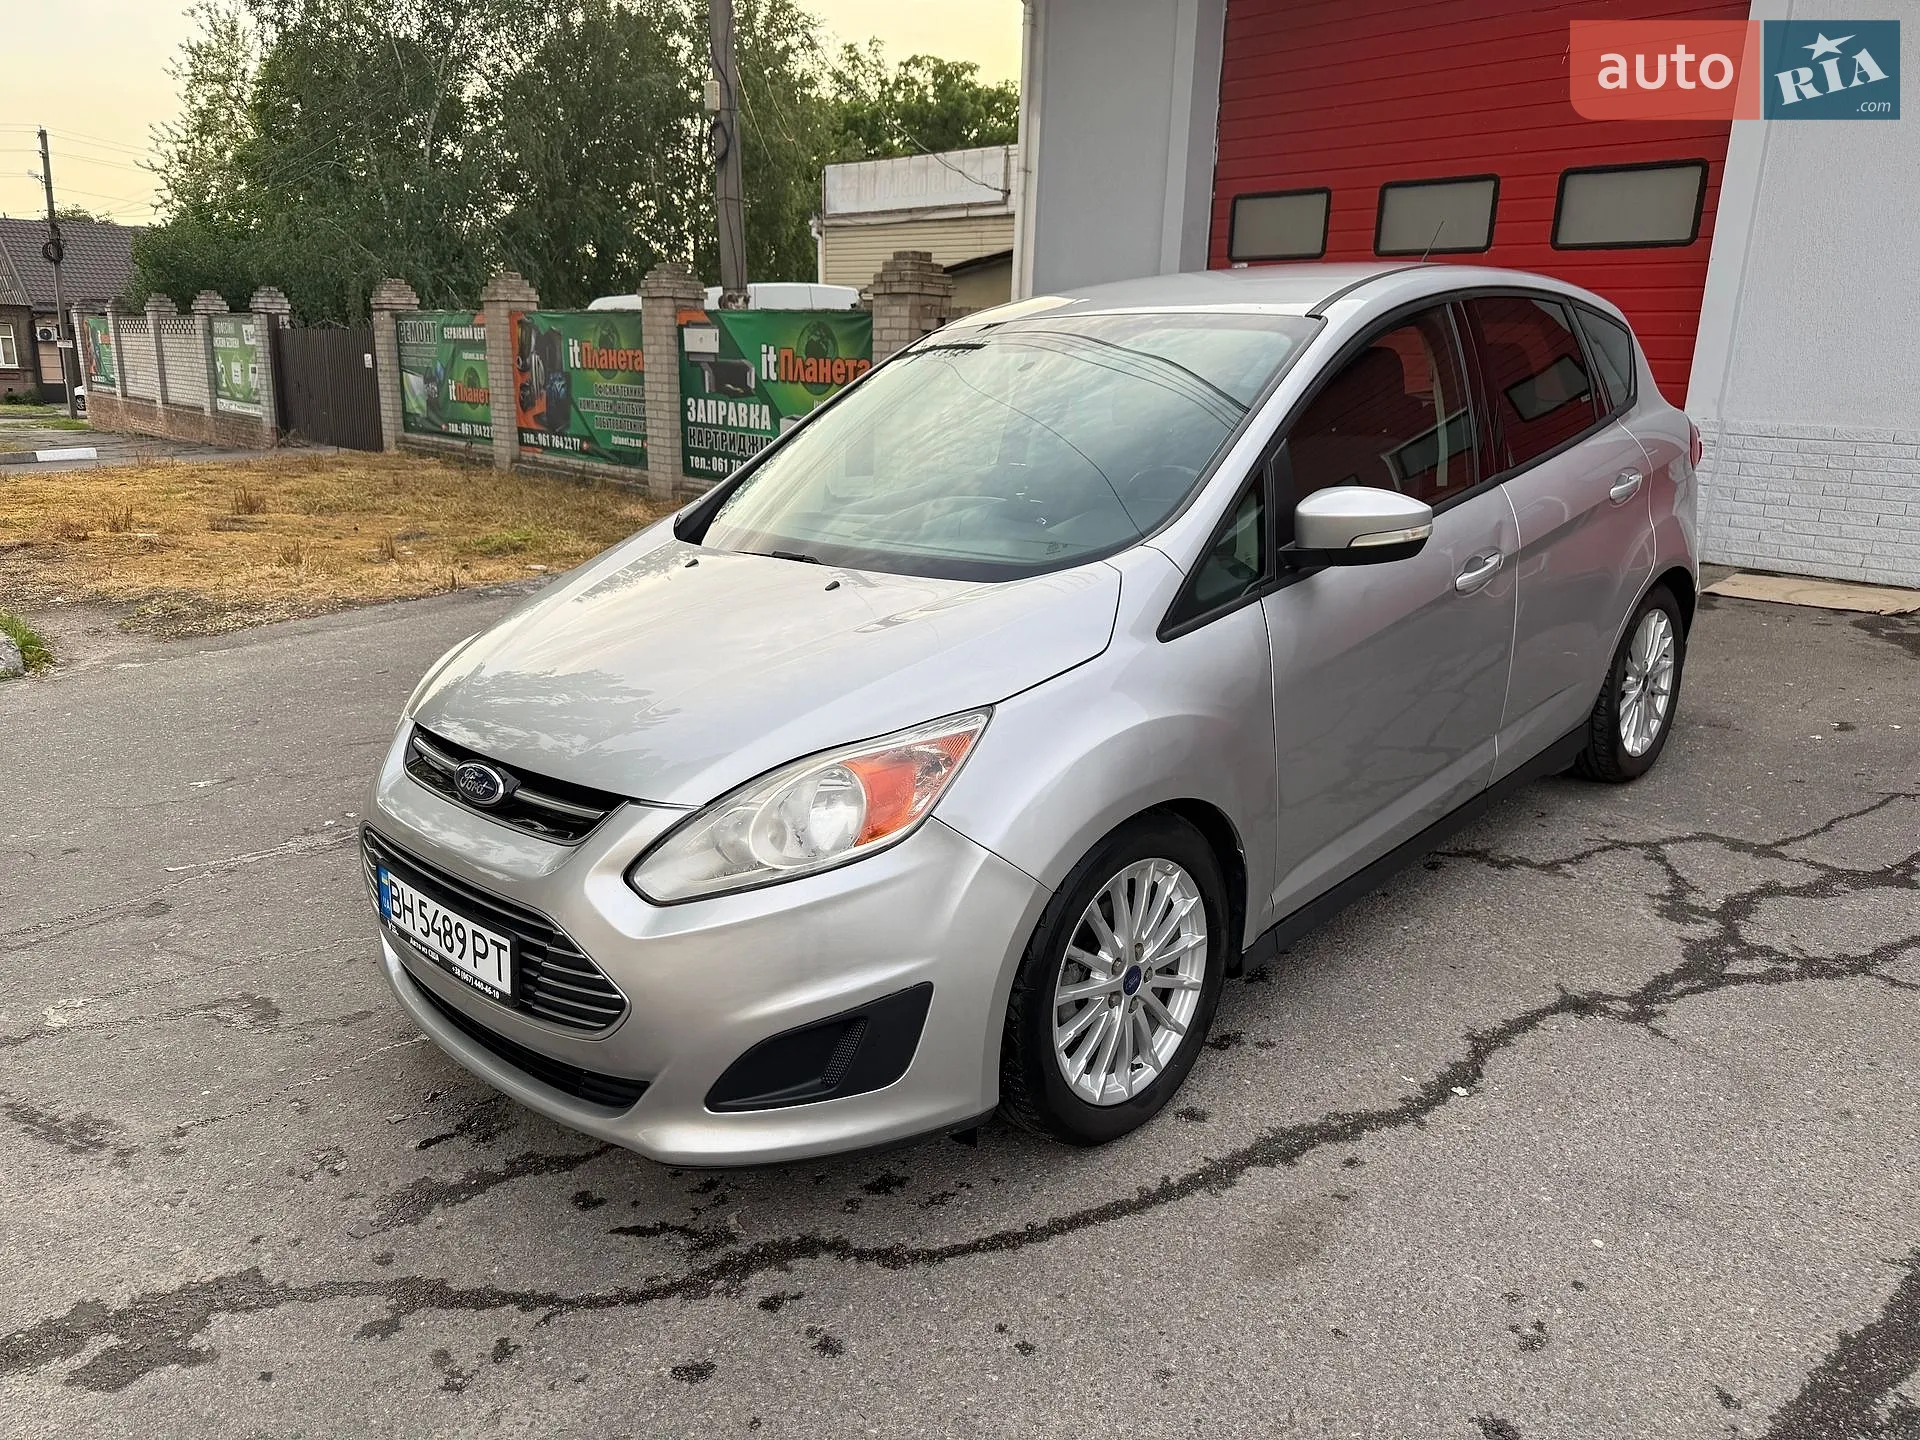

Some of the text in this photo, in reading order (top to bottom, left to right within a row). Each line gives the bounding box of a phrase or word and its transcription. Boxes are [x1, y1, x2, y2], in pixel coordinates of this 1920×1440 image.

[398, 320, 438, 344] РЕМОНТ
[687, 397, 772, 431] ЗАПРАВКА
[689, 455, 711, 470] тел.:
[711, 456, 728, 473] 061
[460, 768, 494, 795] Ford
[389, 878, 416, 932] BH
[418, 899, 467, 960] 5489
[471, 928, 508, 983] PT
